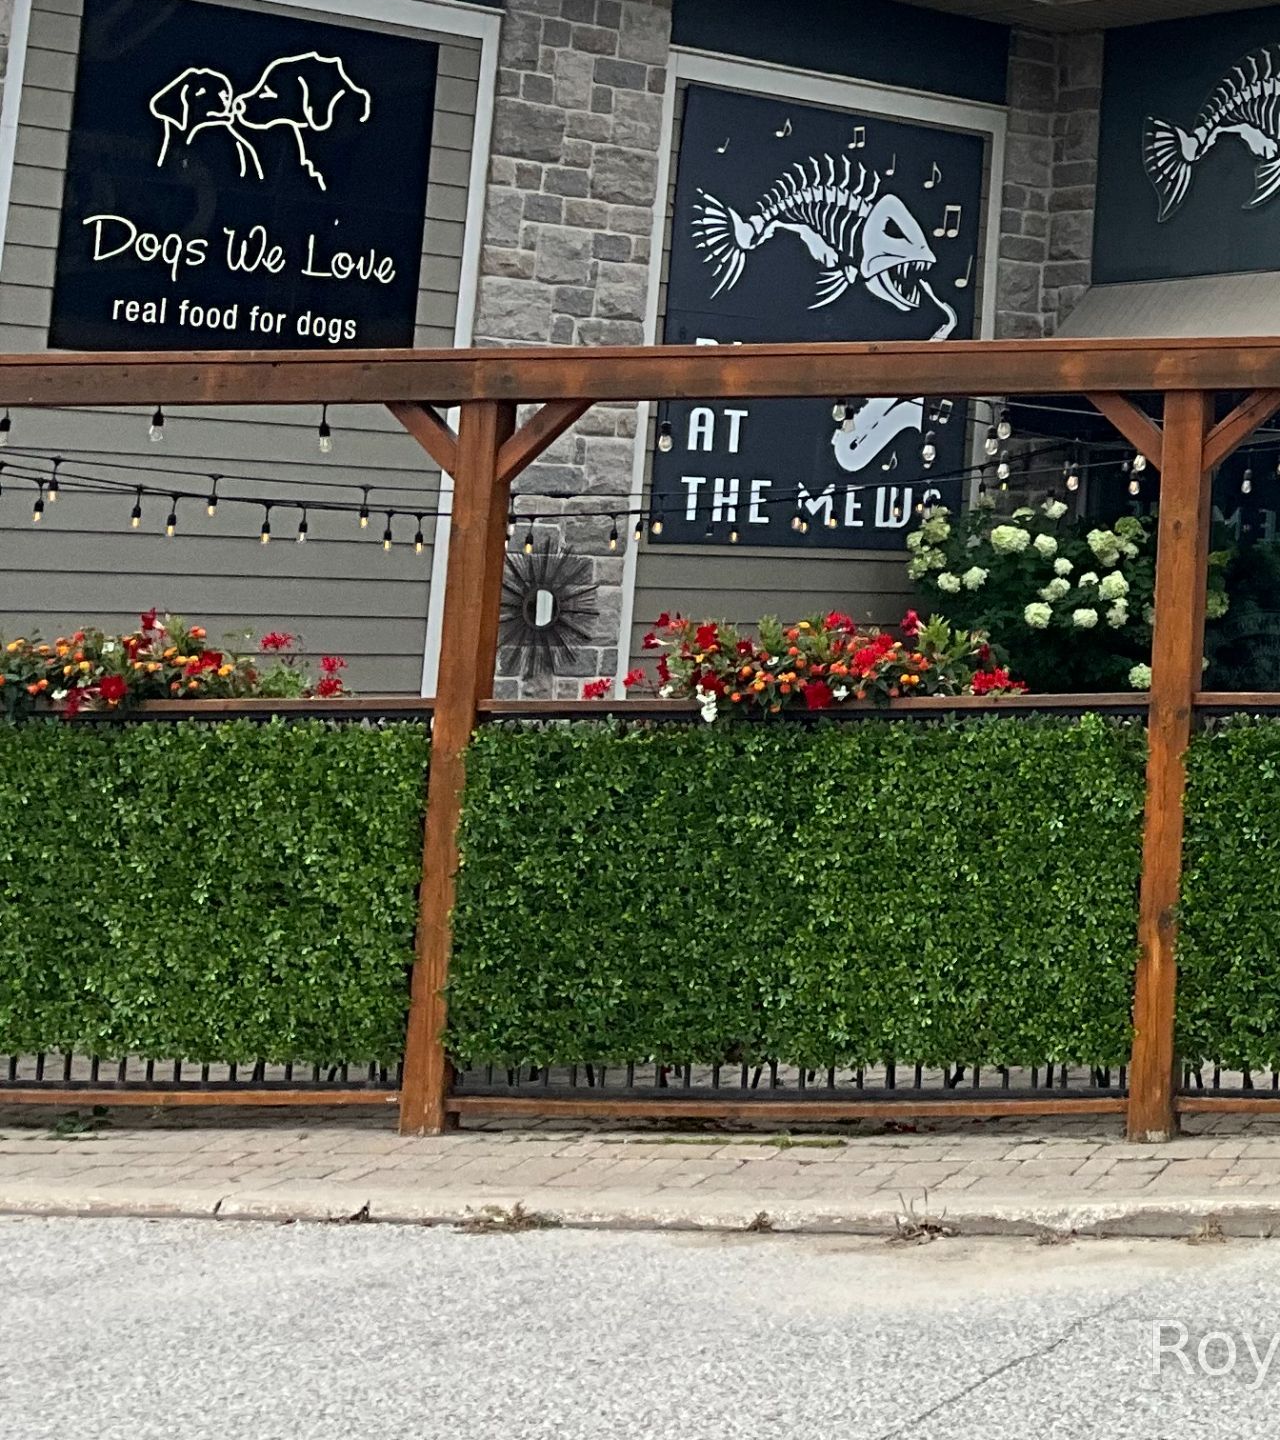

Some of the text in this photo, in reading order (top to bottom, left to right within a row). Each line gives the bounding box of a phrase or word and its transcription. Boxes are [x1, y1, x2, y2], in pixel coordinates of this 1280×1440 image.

[83, 214, 396, 284] Dogs We Love
[112, 297, 357, 343] real food for dogs
[687, 407, 748, 453] AT
[681, 476, 772, 523] THE
